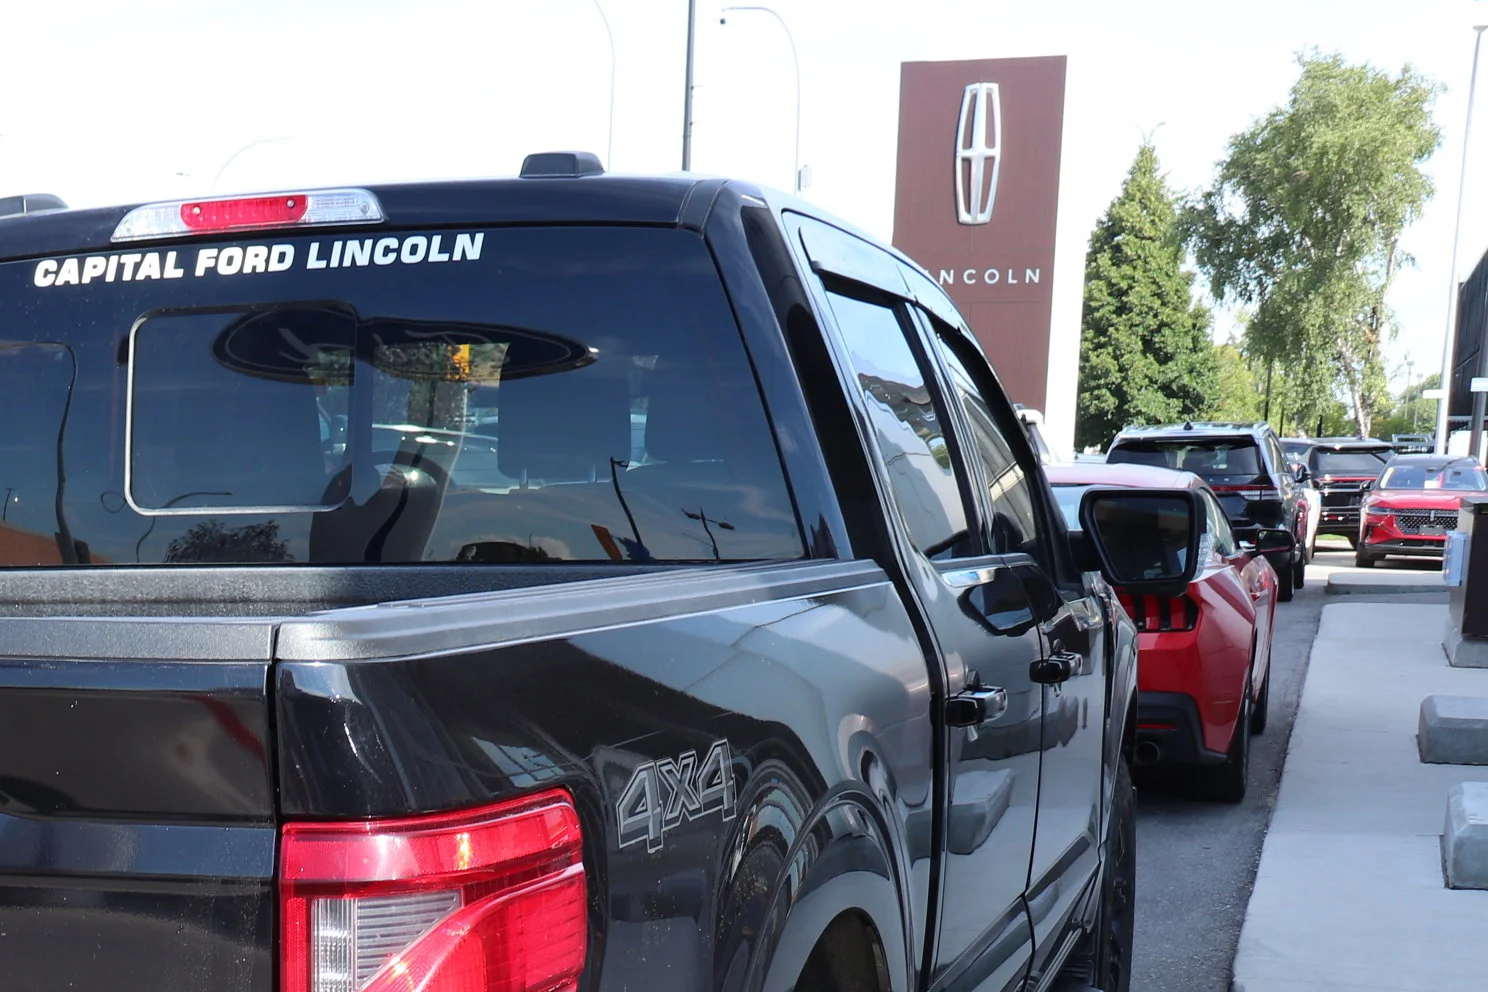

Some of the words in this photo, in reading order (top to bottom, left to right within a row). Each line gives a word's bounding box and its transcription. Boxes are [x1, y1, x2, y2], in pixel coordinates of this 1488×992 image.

[33, 251, 185, 289] CAPITAL
[194, 244, 295, 278] FORD
[305, 231, 486, 271] LINCOLN
[925, 267, 1041, 286] NCOLN
